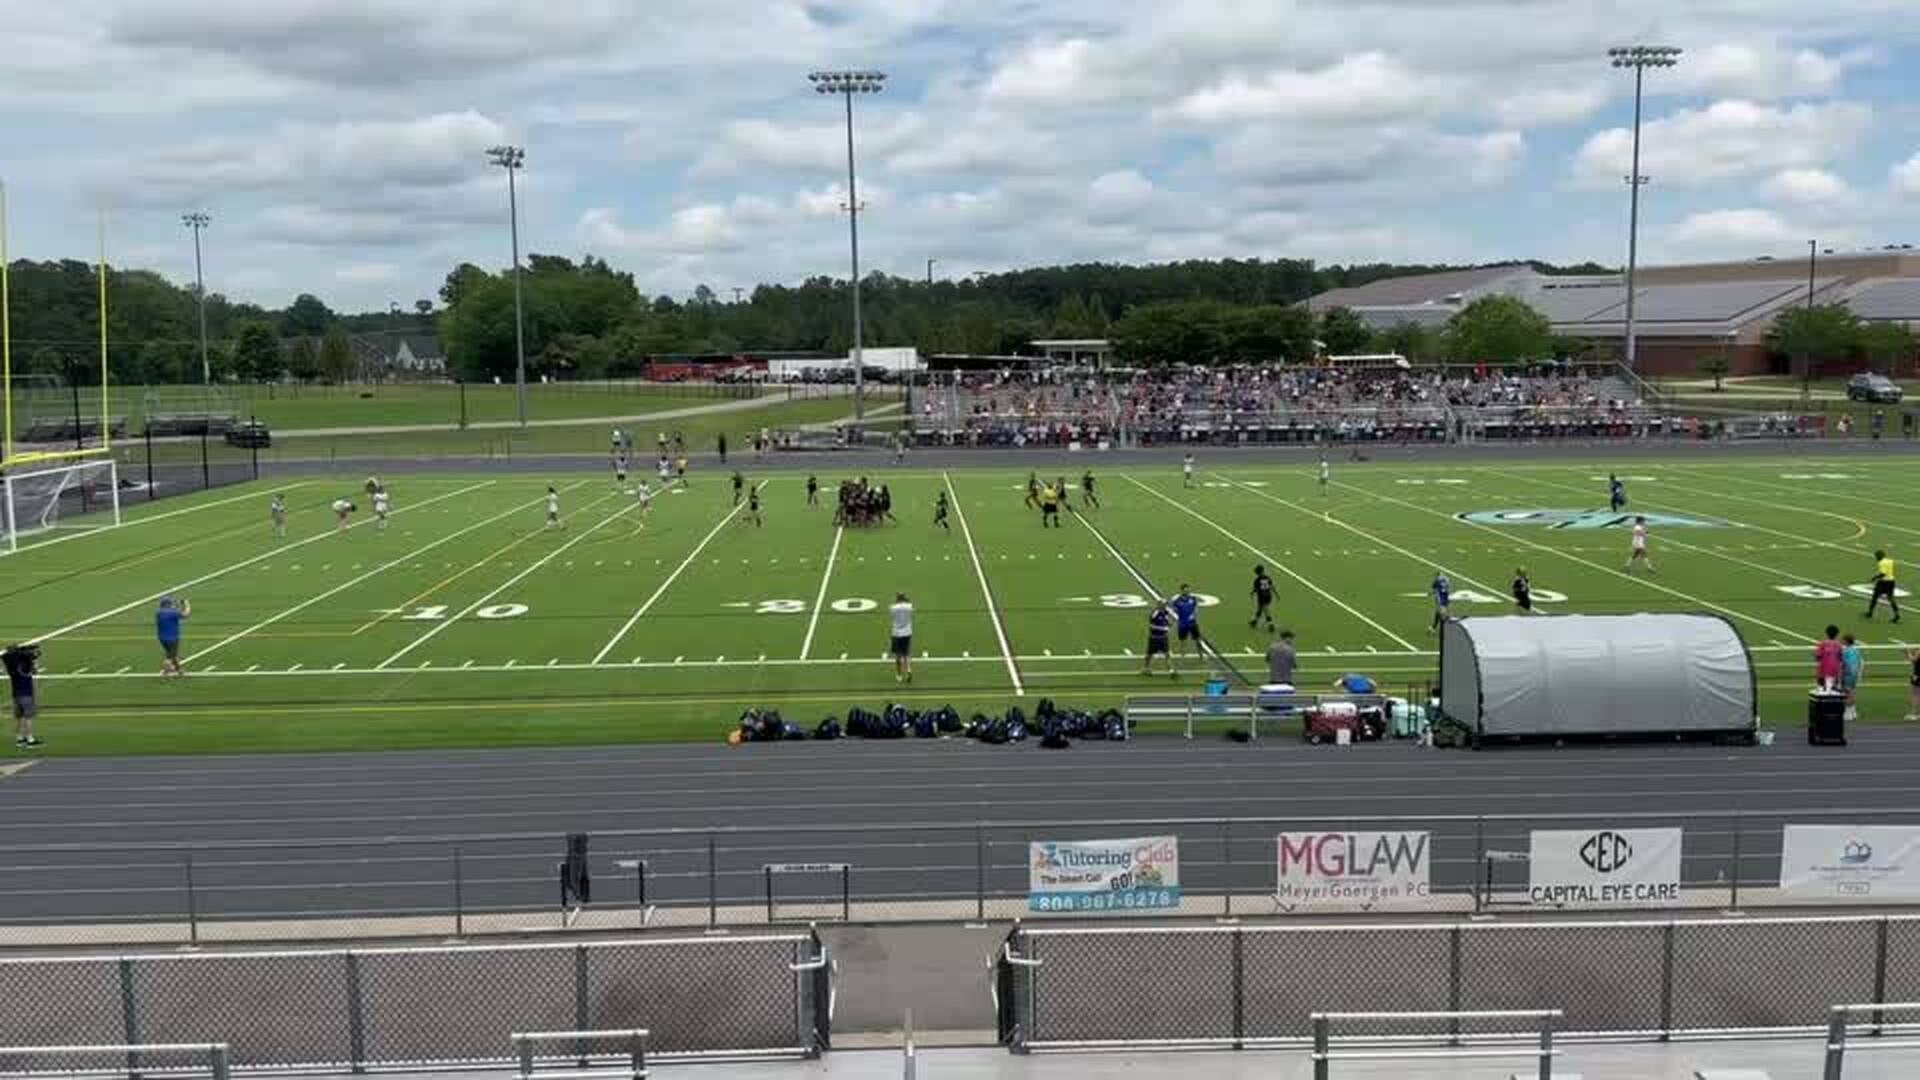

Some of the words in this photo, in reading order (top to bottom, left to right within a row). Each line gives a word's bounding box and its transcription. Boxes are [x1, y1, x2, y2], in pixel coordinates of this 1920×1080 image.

[1059, 848, 1132, 868] Tutoring
[1134, 842, 1175, 864] Club
[1405, 882, 1428, 897] PC
[1531, 885, 1597, 902] CAPITAL
[1601, 884, 1632, 901] EYE
[1634, 882, 1679, 899] CARE
